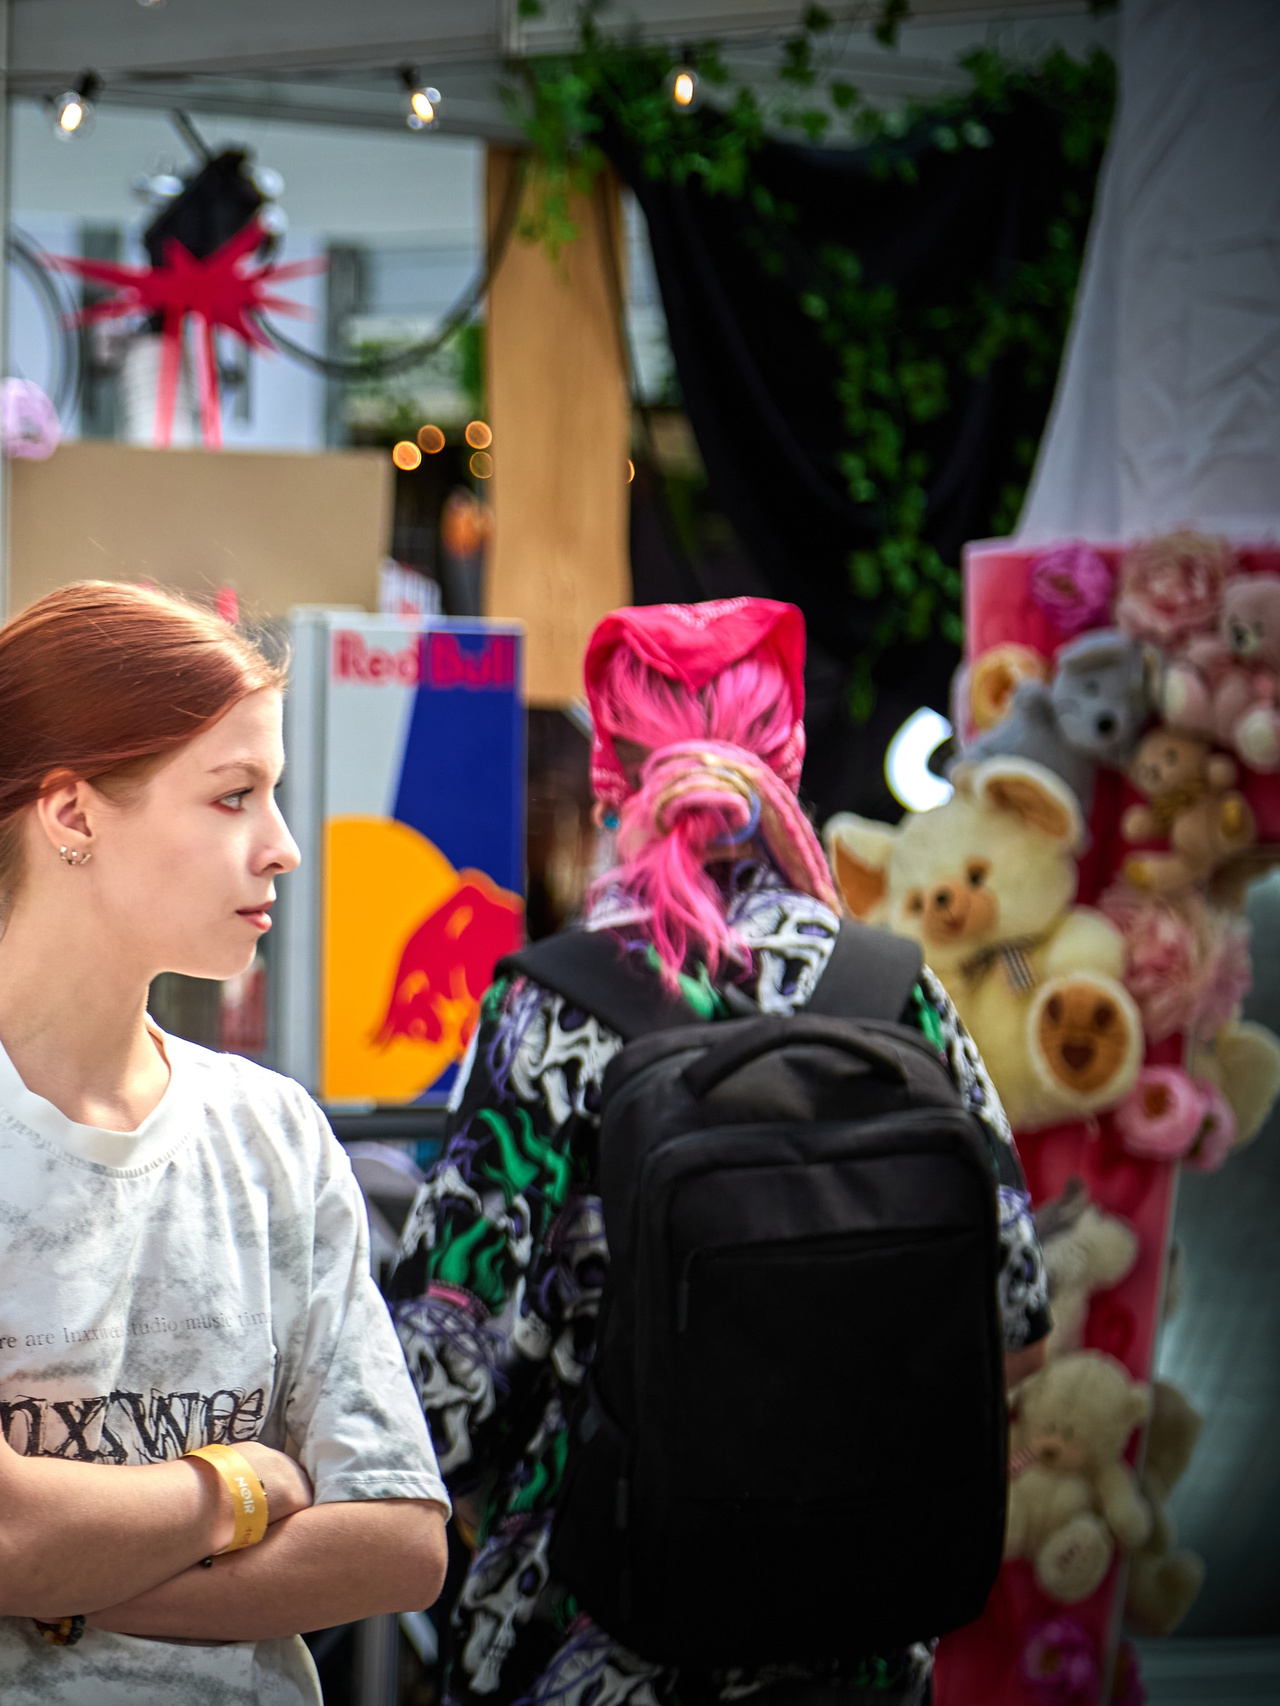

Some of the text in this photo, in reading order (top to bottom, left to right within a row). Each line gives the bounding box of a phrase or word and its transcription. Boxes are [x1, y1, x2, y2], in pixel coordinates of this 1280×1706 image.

[331, 628, 516, 689] Red Bull
[25, 1331, 55, 1347] are
[185, 1312, 232, 1330] music
